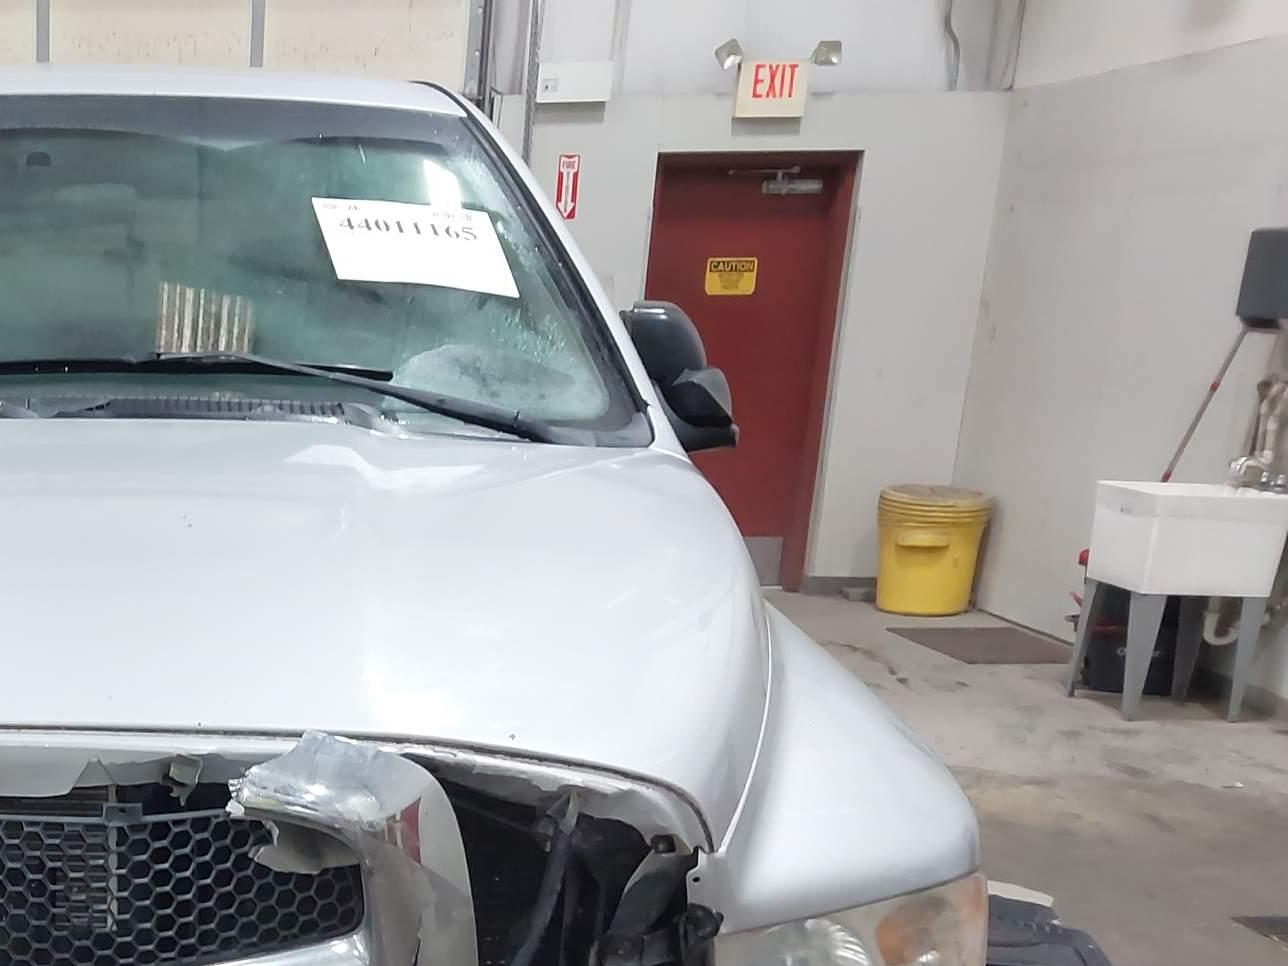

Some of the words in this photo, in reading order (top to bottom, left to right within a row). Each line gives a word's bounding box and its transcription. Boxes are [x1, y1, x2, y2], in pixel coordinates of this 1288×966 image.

[752, 64, 799, 98] EXIT
[339, 216, 478, 241] 44011165
[711, 261, 754, 271] CAUTION
